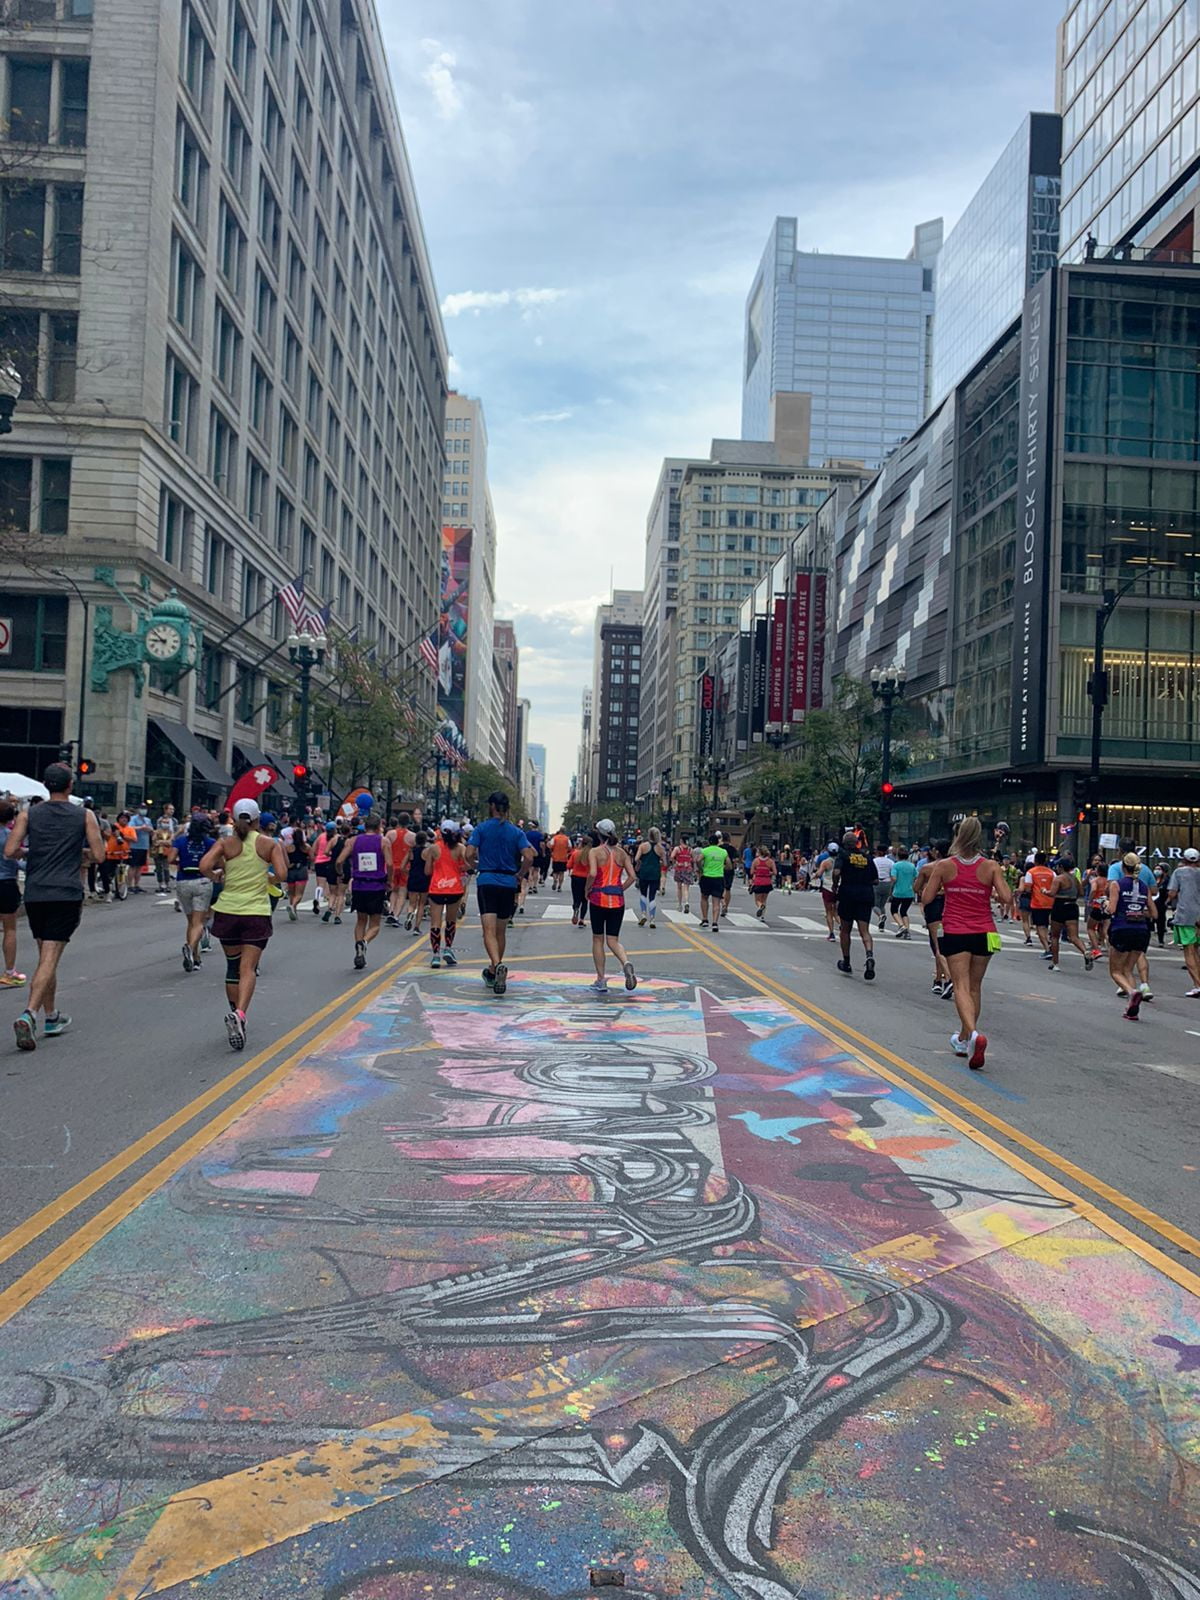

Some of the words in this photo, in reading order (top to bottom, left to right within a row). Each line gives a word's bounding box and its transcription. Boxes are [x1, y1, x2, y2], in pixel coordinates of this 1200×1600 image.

[1028, 292, 1041, 383] SEVEN
[1026, 392, 1039, 484] THIRTY
[1023, 489, 1036, 585] BLOCK
[798, 590, 807, 617] STATE
[775, 622, 784, 651] DINING
[797, 629, 806, 646] 108
[797, 651, 805, 661] AT
[740, 663, 750, 714] francesca's
[774, 667, 782, 707] SHOPPING
[796, 664, 804, 693] SHOPS
[1022, 688, 1028, 702] AT
[1135, 845, 1185, 859] ZAR
